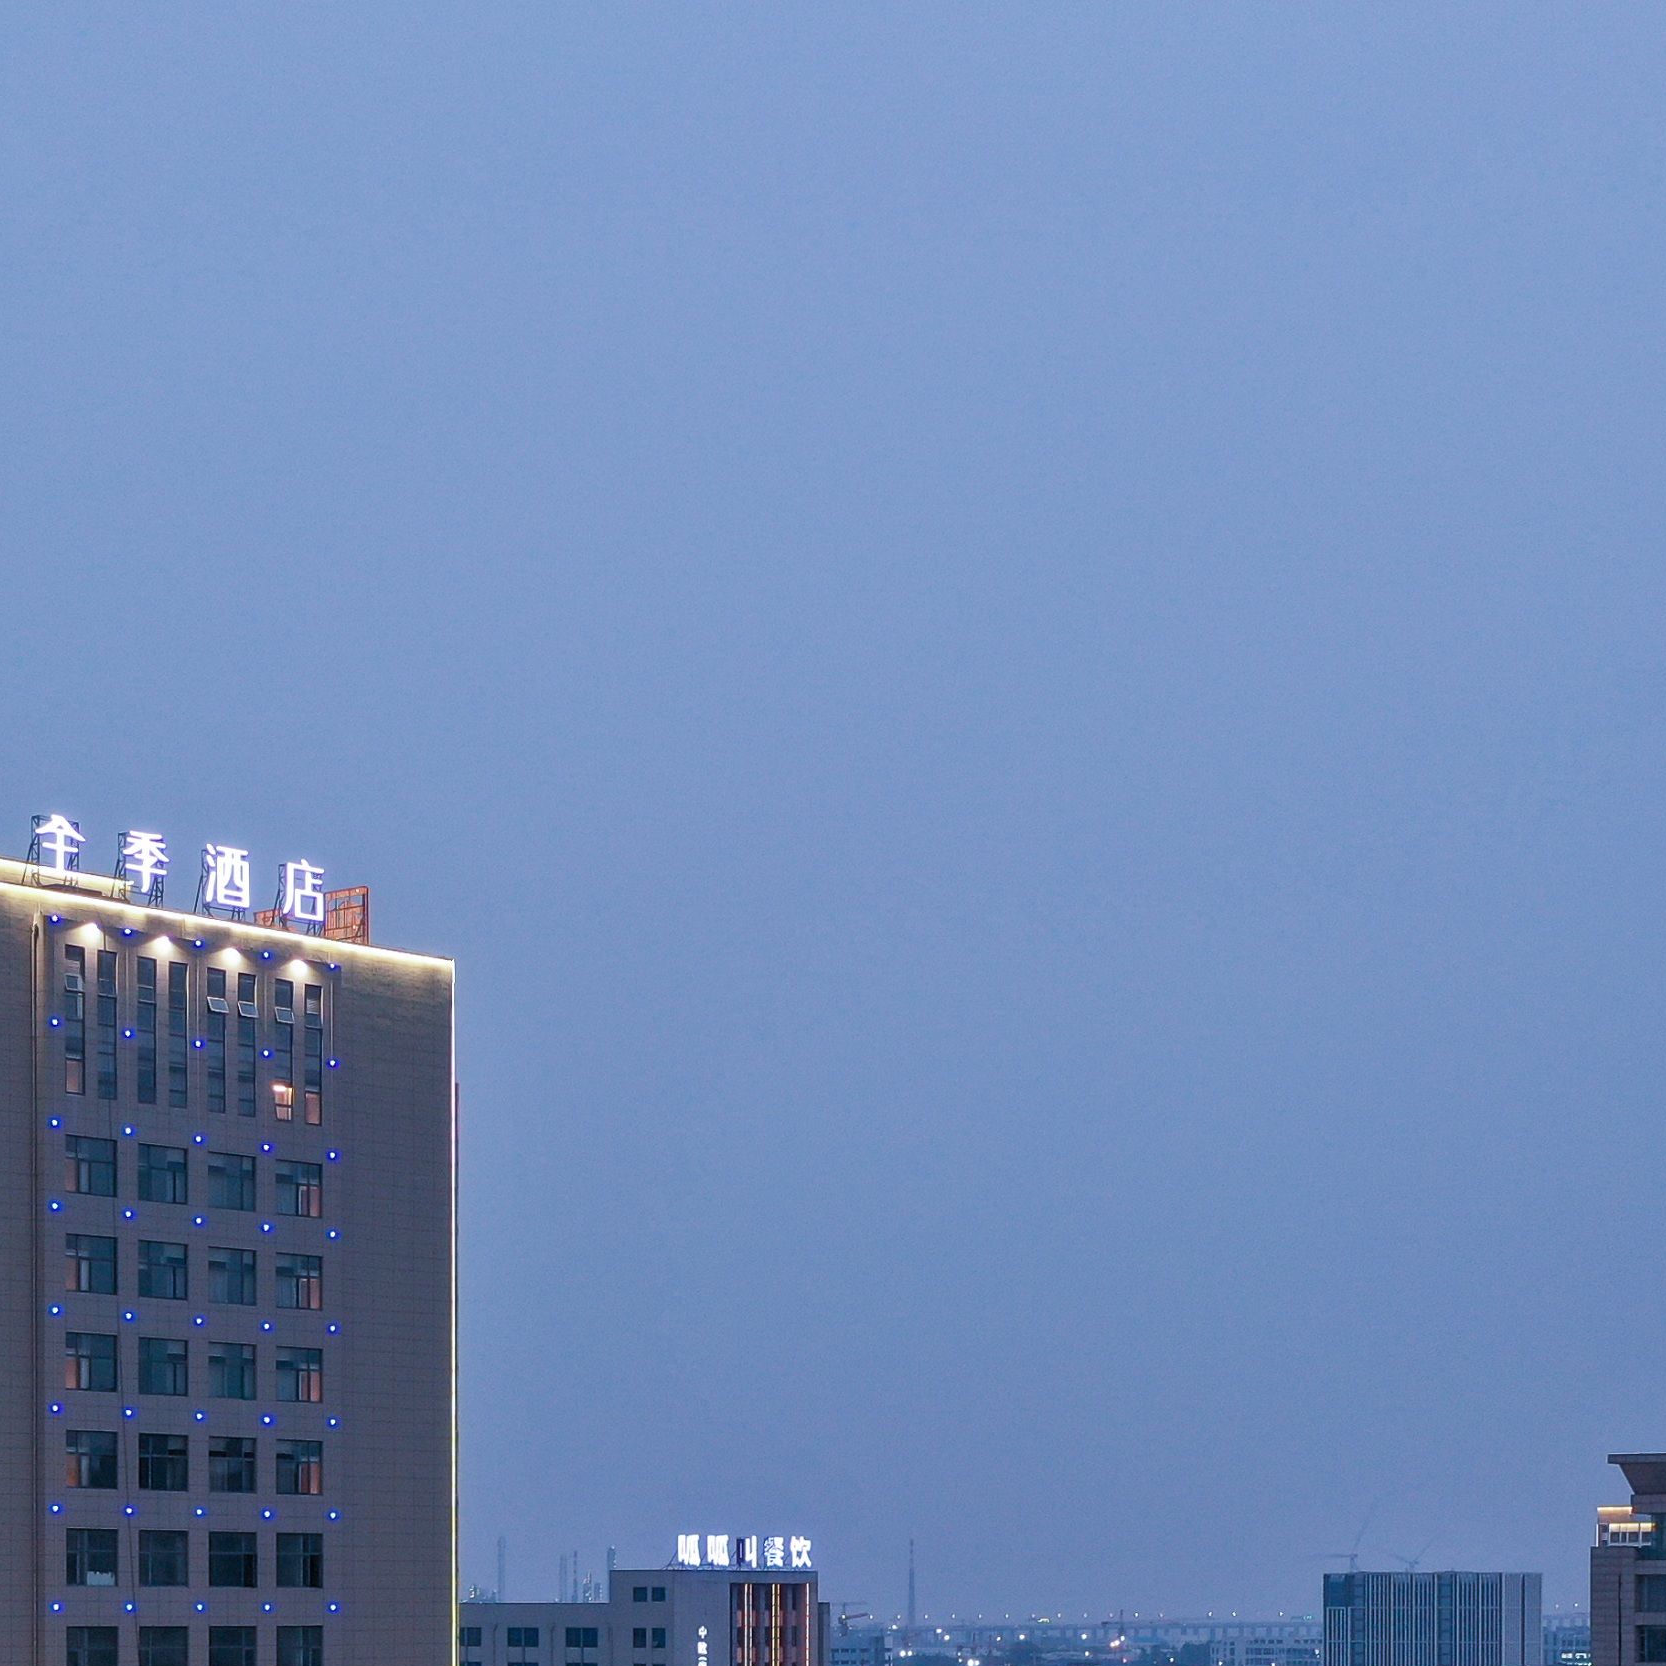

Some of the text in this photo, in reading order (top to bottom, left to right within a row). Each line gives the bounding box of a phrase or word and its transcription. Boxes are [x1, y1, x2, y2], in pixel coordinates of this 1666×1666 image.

[35, 815, 324, 922] 全季酒店
[678, 1534, 812, 1568] 呱呱叫餐饮
